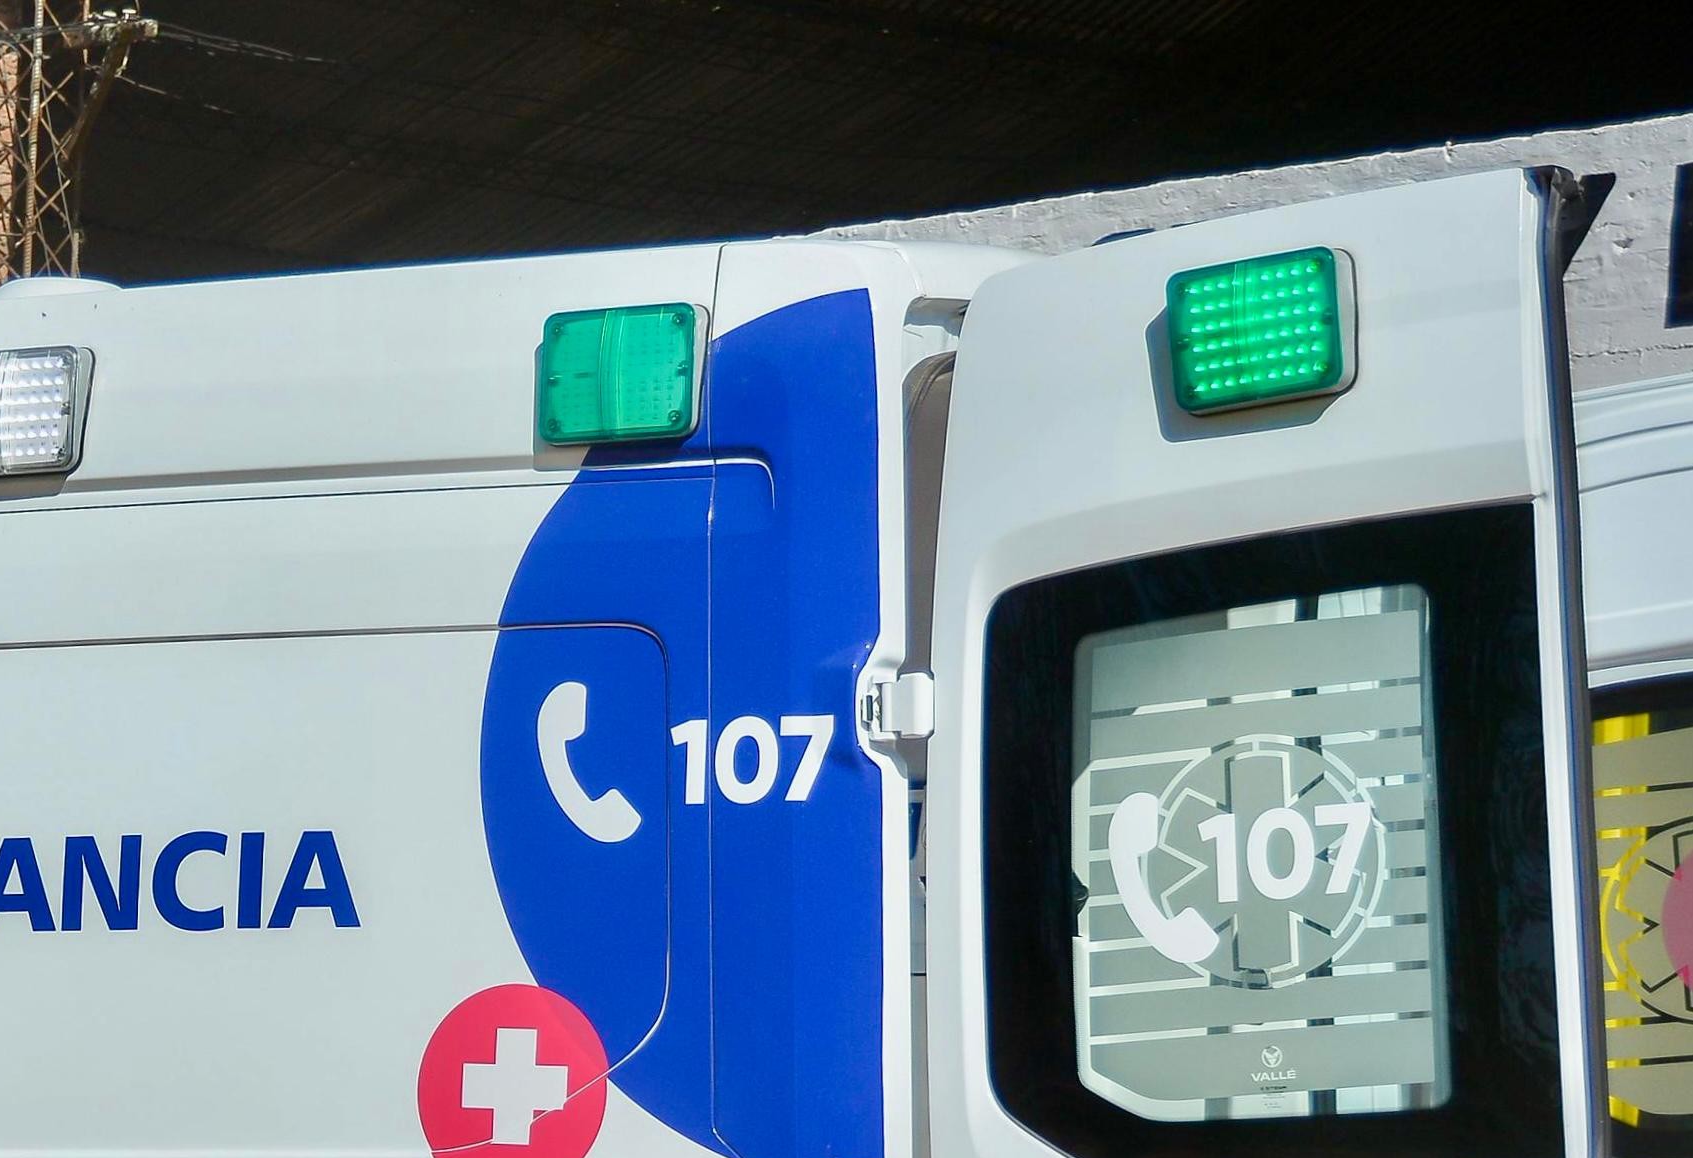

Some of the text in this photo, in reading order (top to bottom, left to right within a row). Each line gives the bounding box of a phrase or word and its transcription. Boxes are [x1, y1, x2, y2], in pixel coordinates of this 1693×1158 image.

[670, 715, 834, 805] 107
[1197, 802, 1371, 903] 107
[1251, 1068, 1296, 1081] VALLÉ
